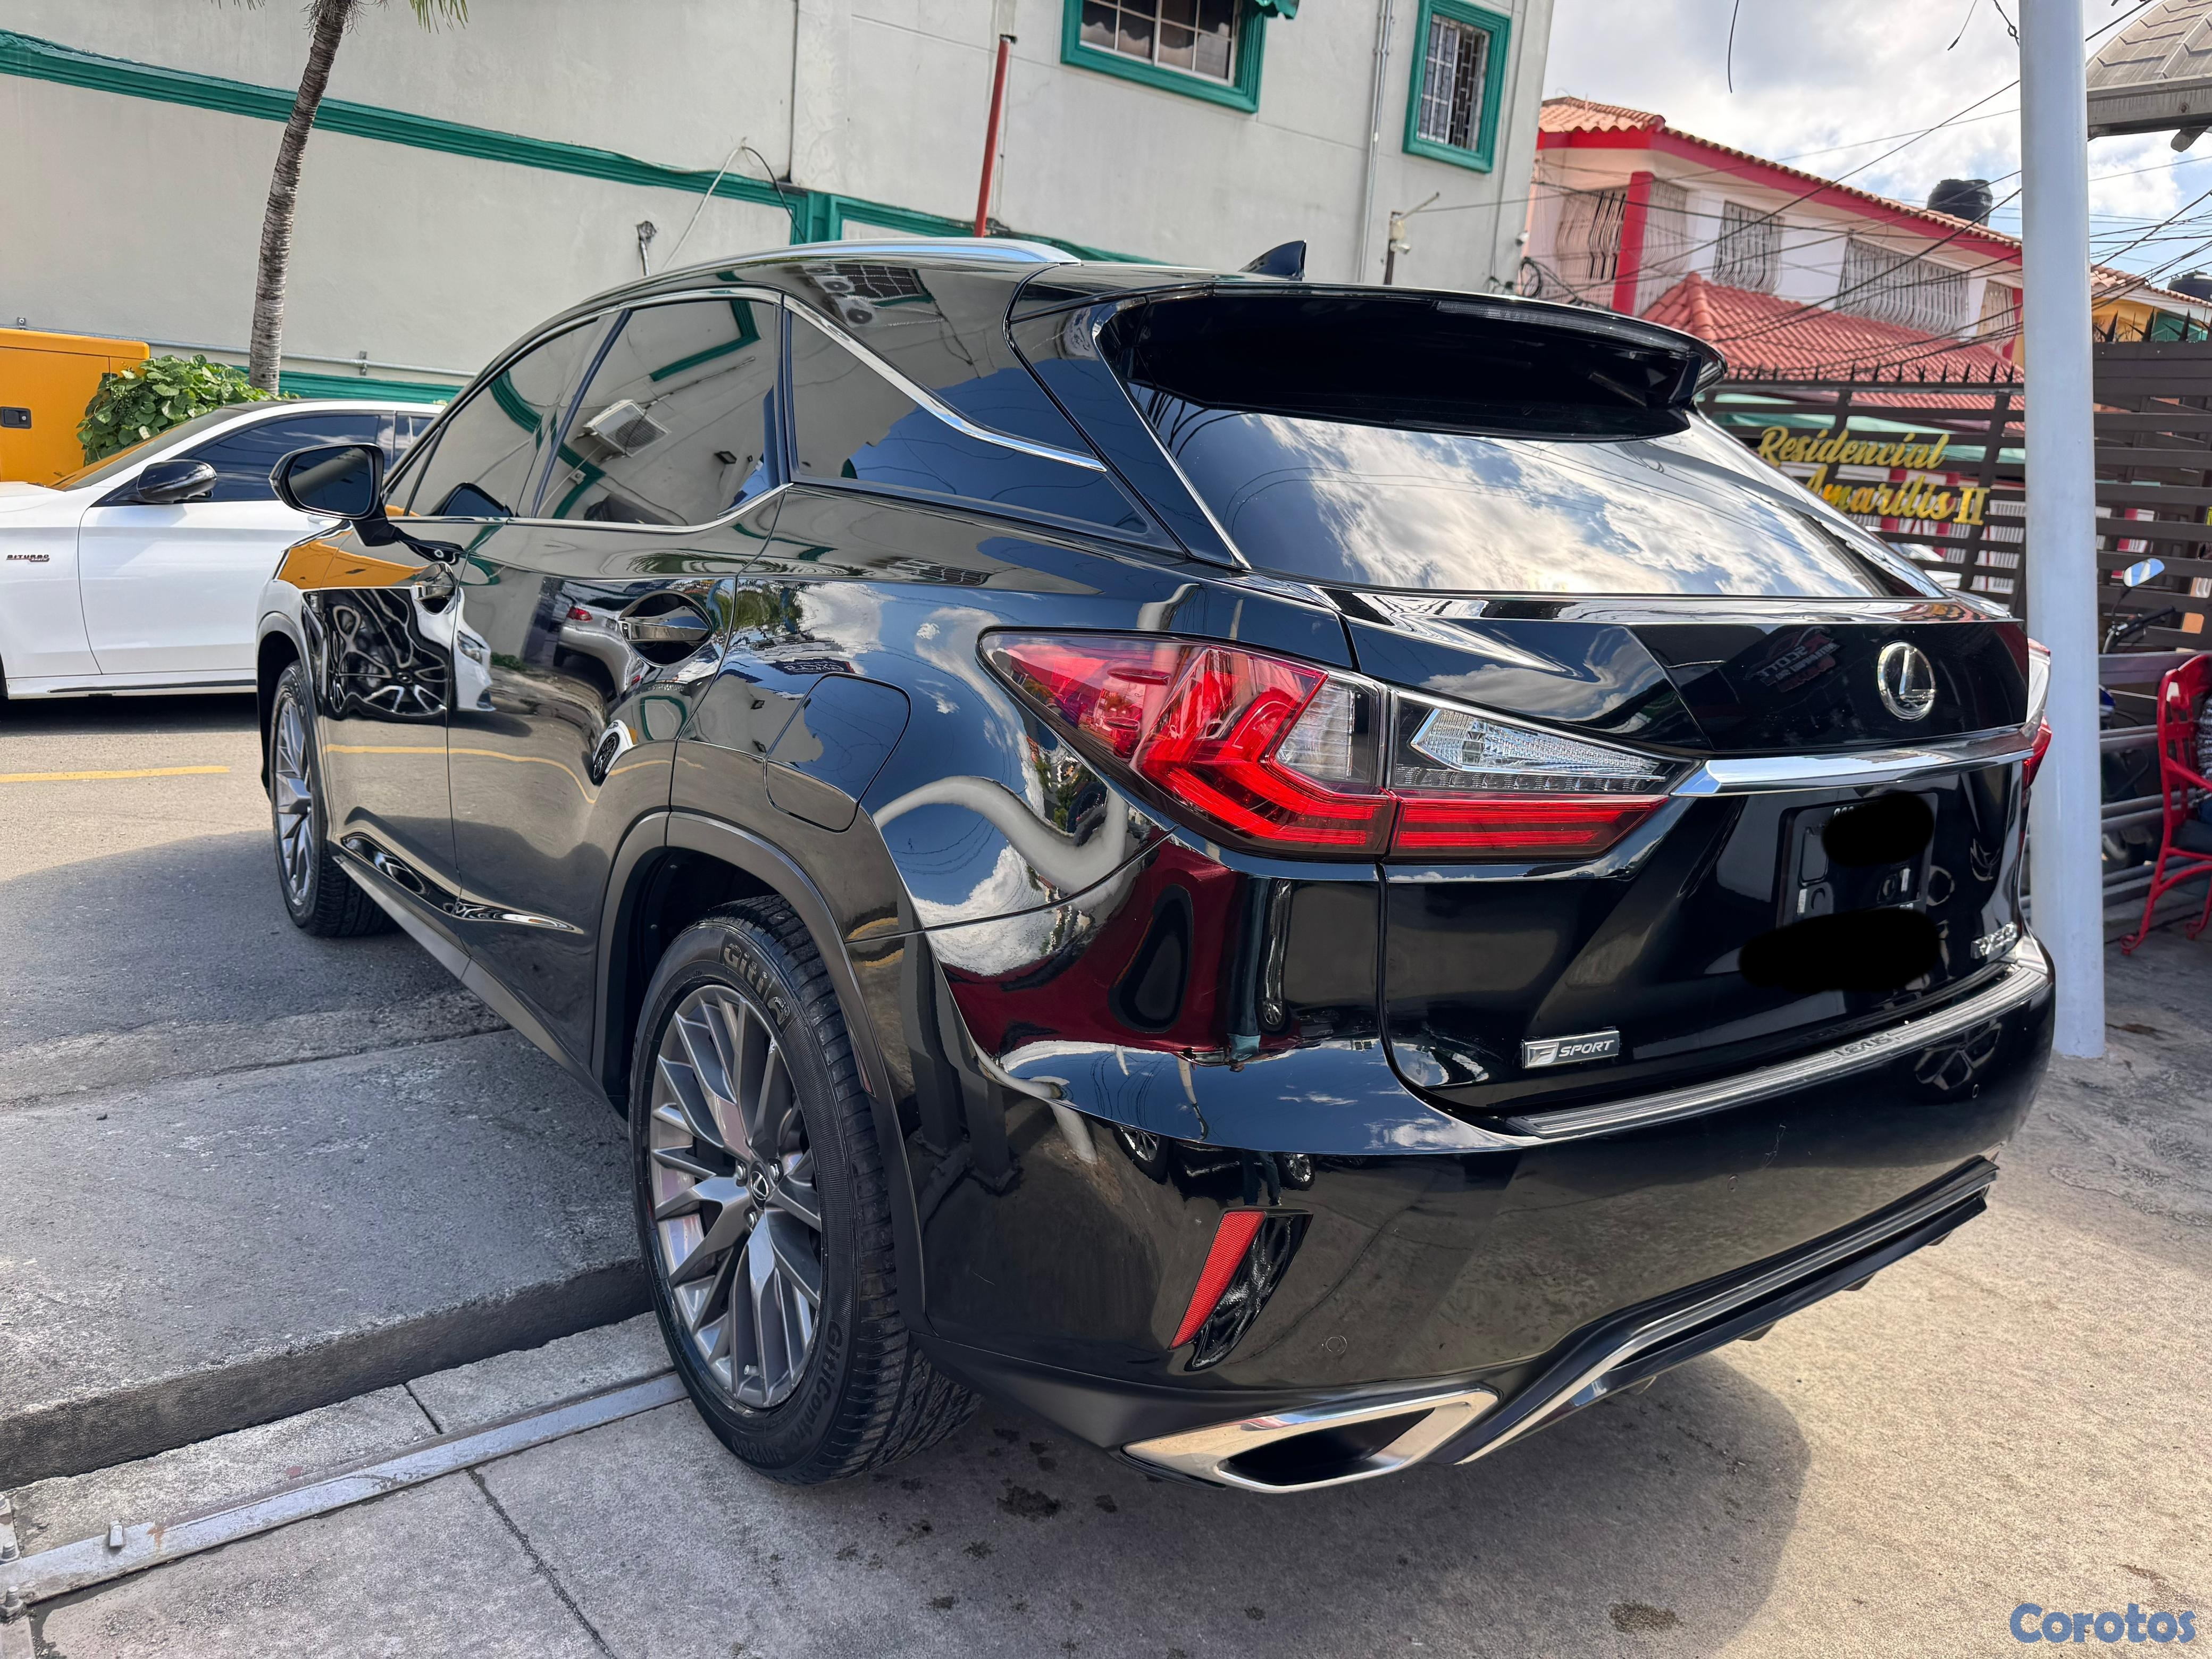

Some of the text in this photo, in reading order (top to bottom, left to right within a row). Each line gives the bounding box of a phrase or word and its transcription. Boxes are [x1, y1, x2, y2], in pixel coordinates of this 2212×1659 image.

[1757, 426, 1950, 470] Residencial
[1806, 464, 1991, 526] Amarilis II
[723, 942, 769, 994] Giti
[1558, 1040, 1615, 1057] SPORT
[1833, 1036, 1893, 1056] LEXUS
